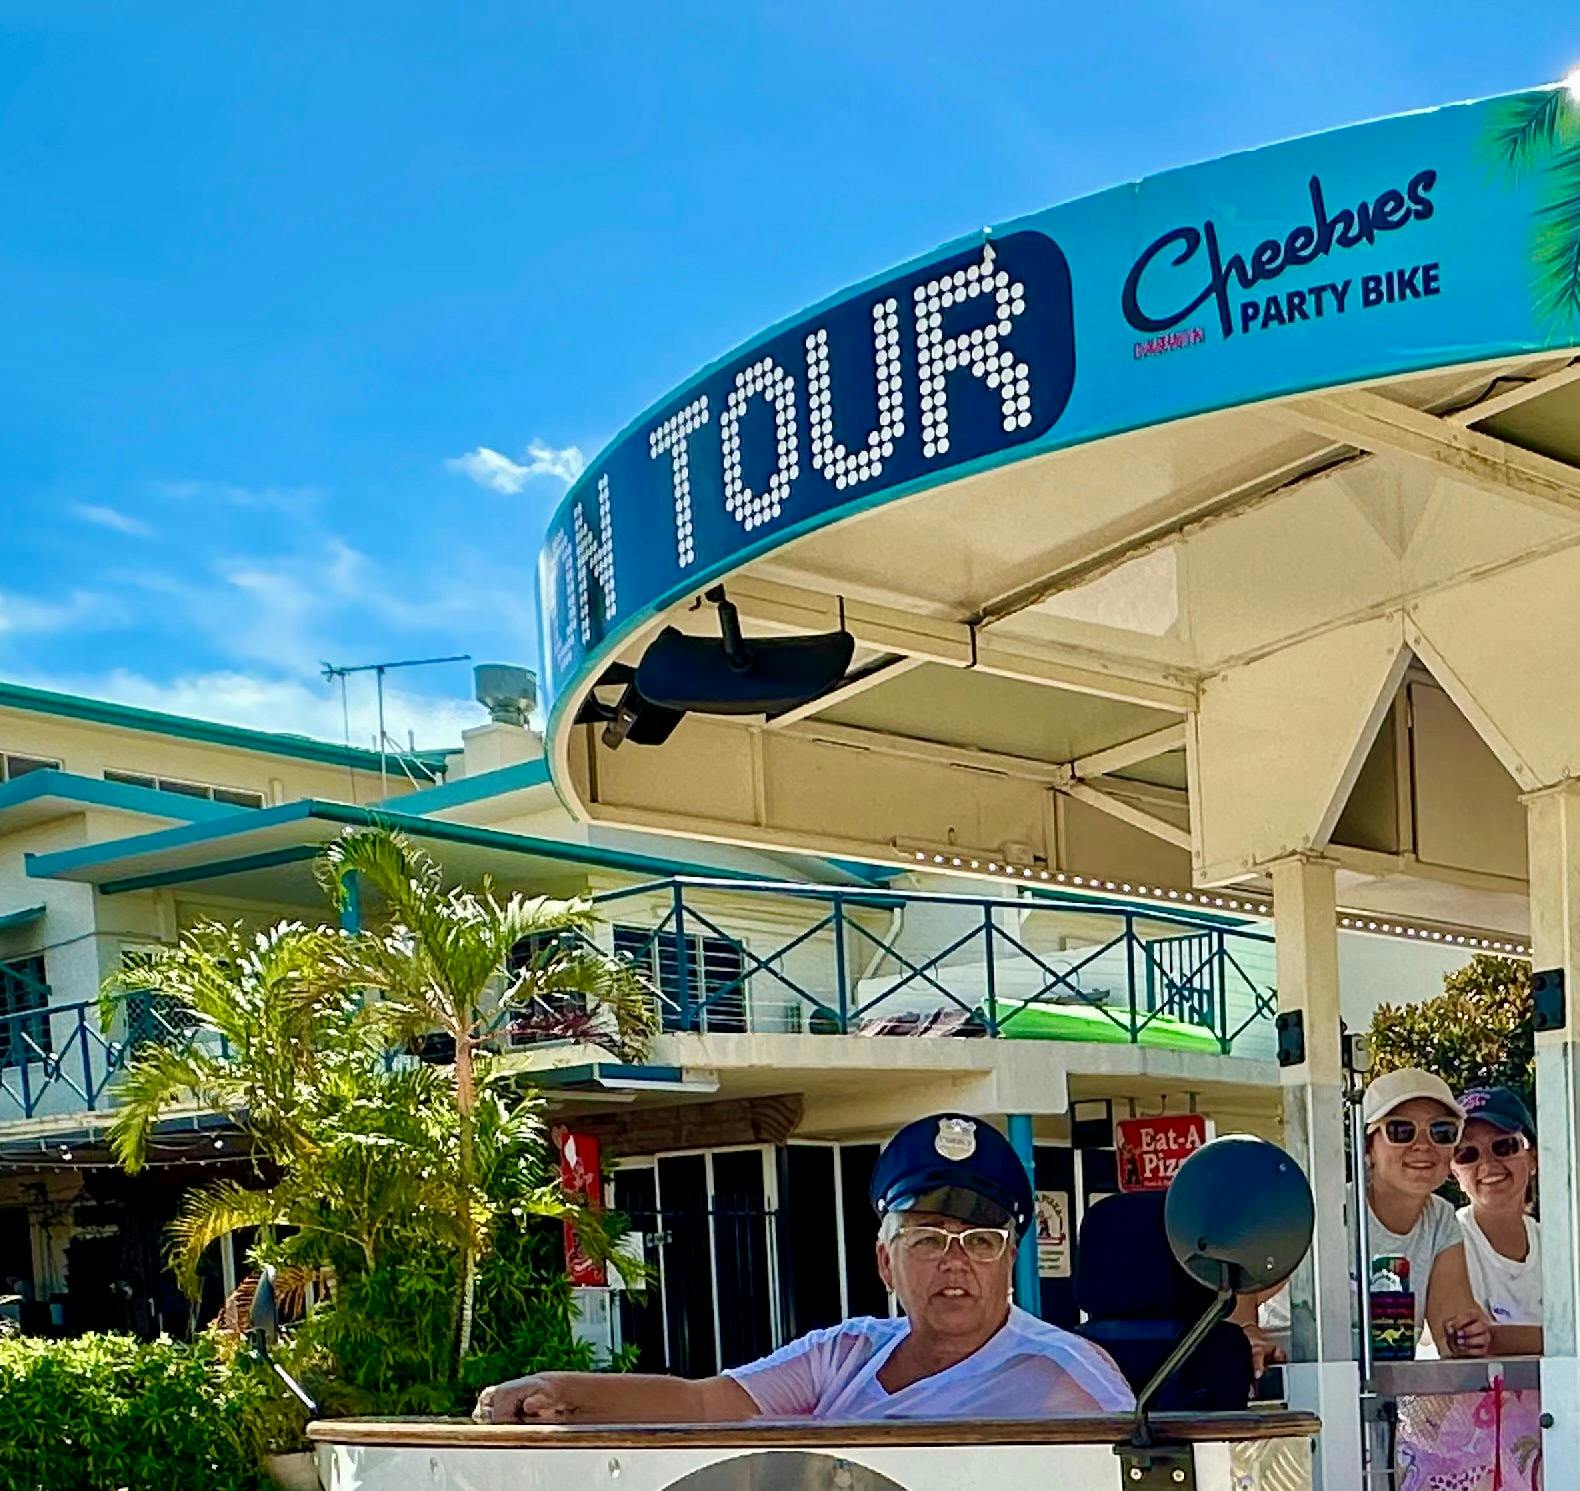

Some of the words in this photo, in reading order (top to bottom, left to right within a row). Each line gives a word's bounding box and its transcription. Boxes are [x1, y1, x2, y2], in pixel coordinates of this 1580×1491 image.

[1121, 169, 1438, 340] Cheekies
[1241, 278, 1352, 334] PARTY
[1362, 261, 1442, 309] BIKE
[649, 258, 1033, 568] TOUR
